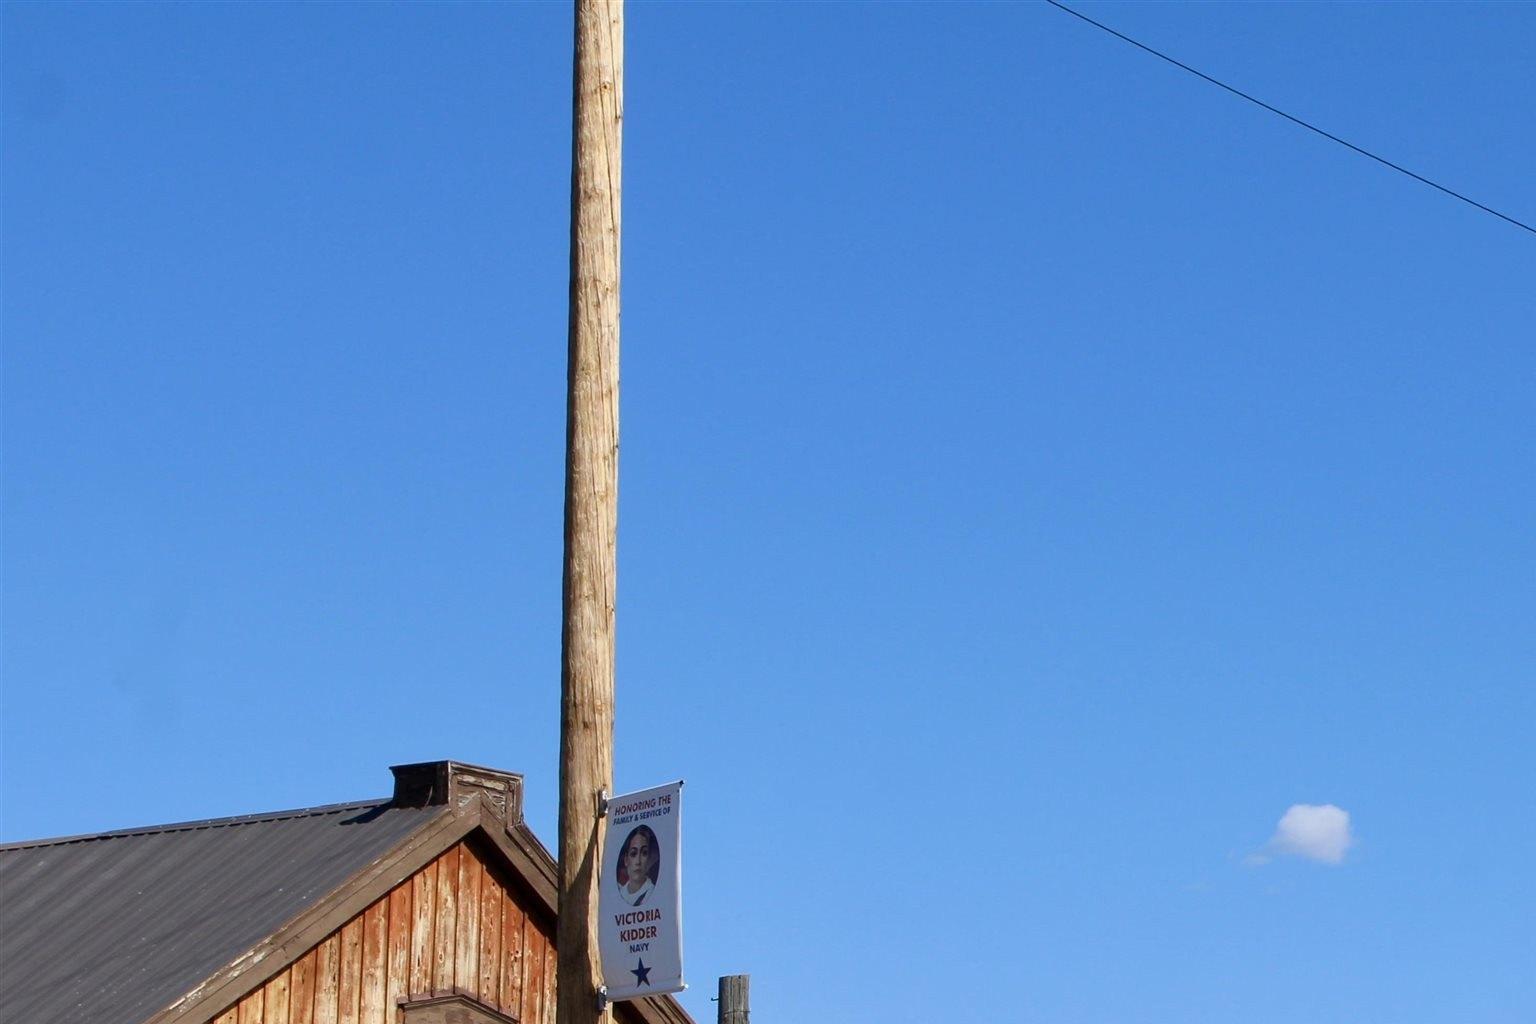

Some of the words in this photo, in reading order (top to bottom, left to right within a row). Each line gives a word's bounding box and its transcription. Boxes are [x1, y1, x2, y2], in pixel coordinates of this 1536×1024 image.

[615, 798, 656, 816] HONORING
[658, 794, 671, 806] THE
[613, 815, 633, 825] FAMILY
[639, 809, 661, 820] SERVICE
[662, 806, 671, 815] OF
[614, 908, 661, 926] VICTORIA
[620, 925, 657, 942] KIDDER
[629, 942, 650, 953] NAVY
